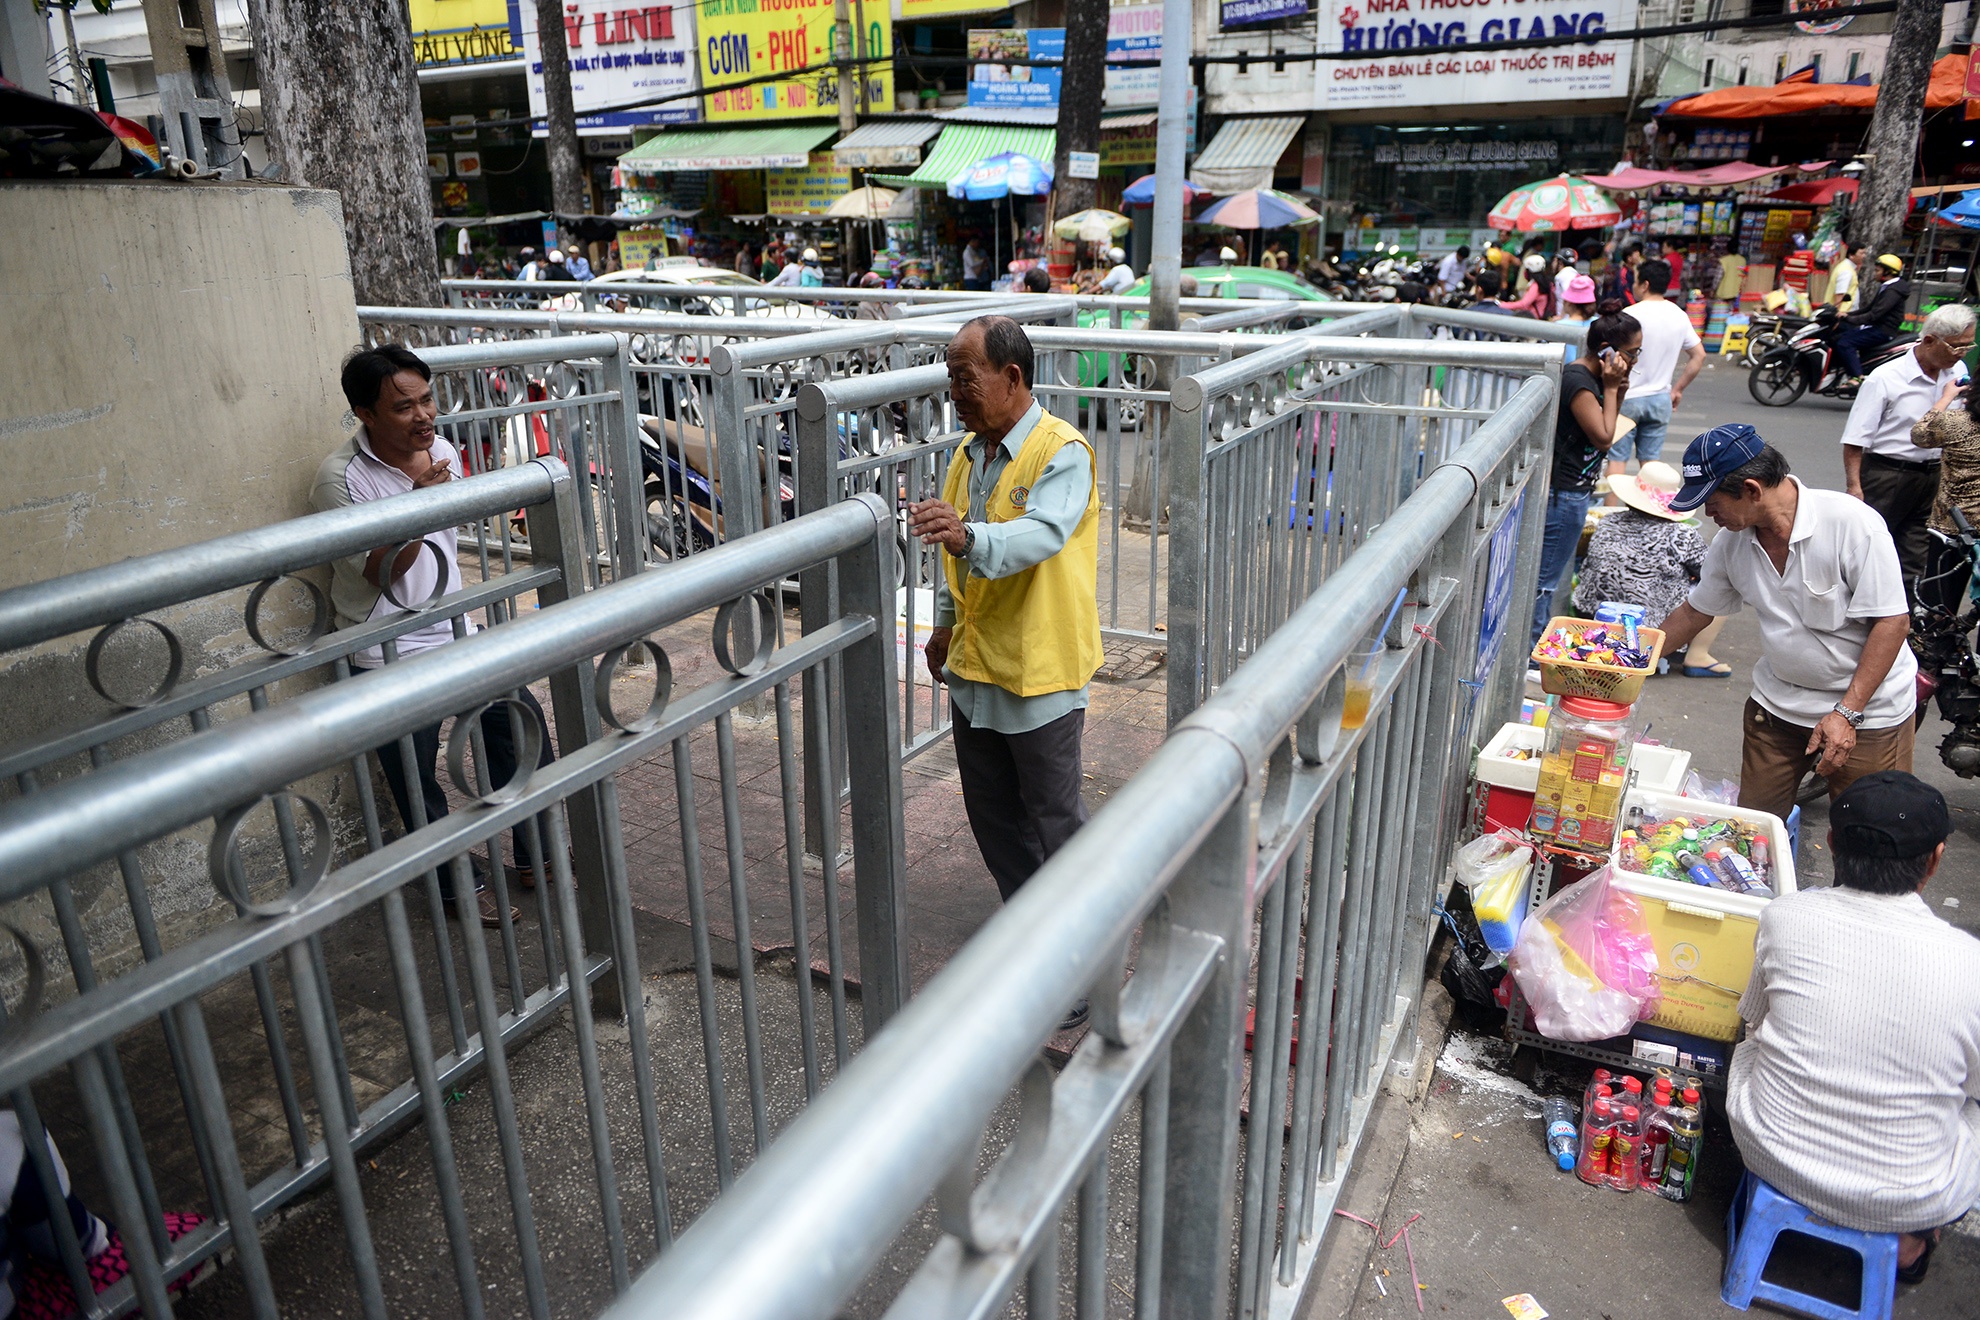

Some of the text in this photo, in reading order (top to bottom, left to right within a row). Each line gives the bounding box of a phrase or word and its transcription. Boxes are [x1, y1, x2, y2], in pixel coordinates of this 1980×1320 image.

[593, 5, 676, 45] LINH
[708, 30, 750, 75] CƠM
[768, 14, 808, 71] PHỞ
[1343, 12, 1605, 53] HƯƠNG GIANG
[1334, 64, 1384, 80] CHUYÊN
[1388, 64, 1414, 77] BÁN
[1436, 59, 1461, 74] CÁC
[1466, 60, 1495, 74] LOẠI
[1502, 52, 1548, 71] THUỐC
[1553, 55, 1574, 70] TRỊ
[1578, 51, 1615, 69] BỆNH
[1375, 138, 1558, 163] NHÀ THUỐC TÂY HƯƠNG GIANG
